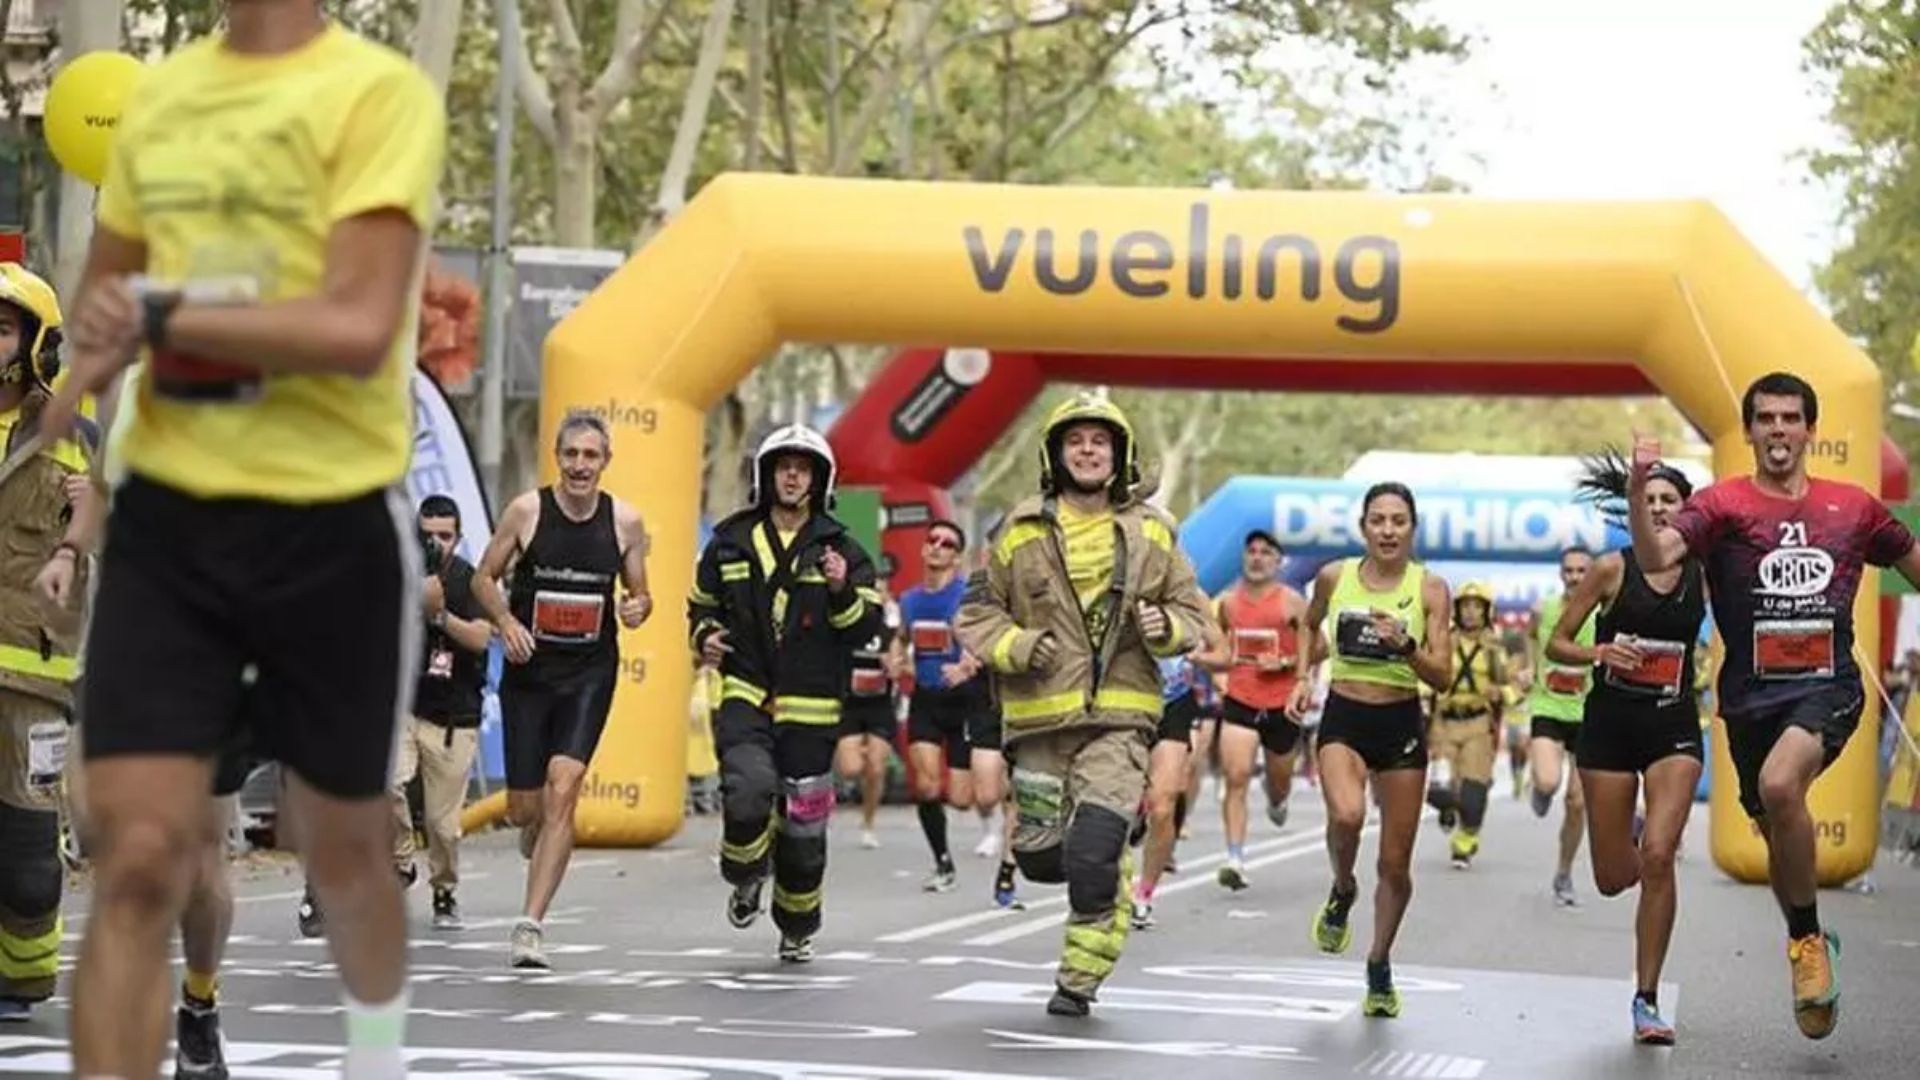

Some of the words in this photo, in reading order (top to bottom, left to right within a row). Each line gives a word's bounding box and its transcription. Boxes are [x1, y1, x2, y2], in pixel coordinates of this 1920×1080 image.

[963, 202, 1401, 334] vueling
[1273, 494, 1608, 552] DETHLON
[1779, 521, 1807, 546] 21
